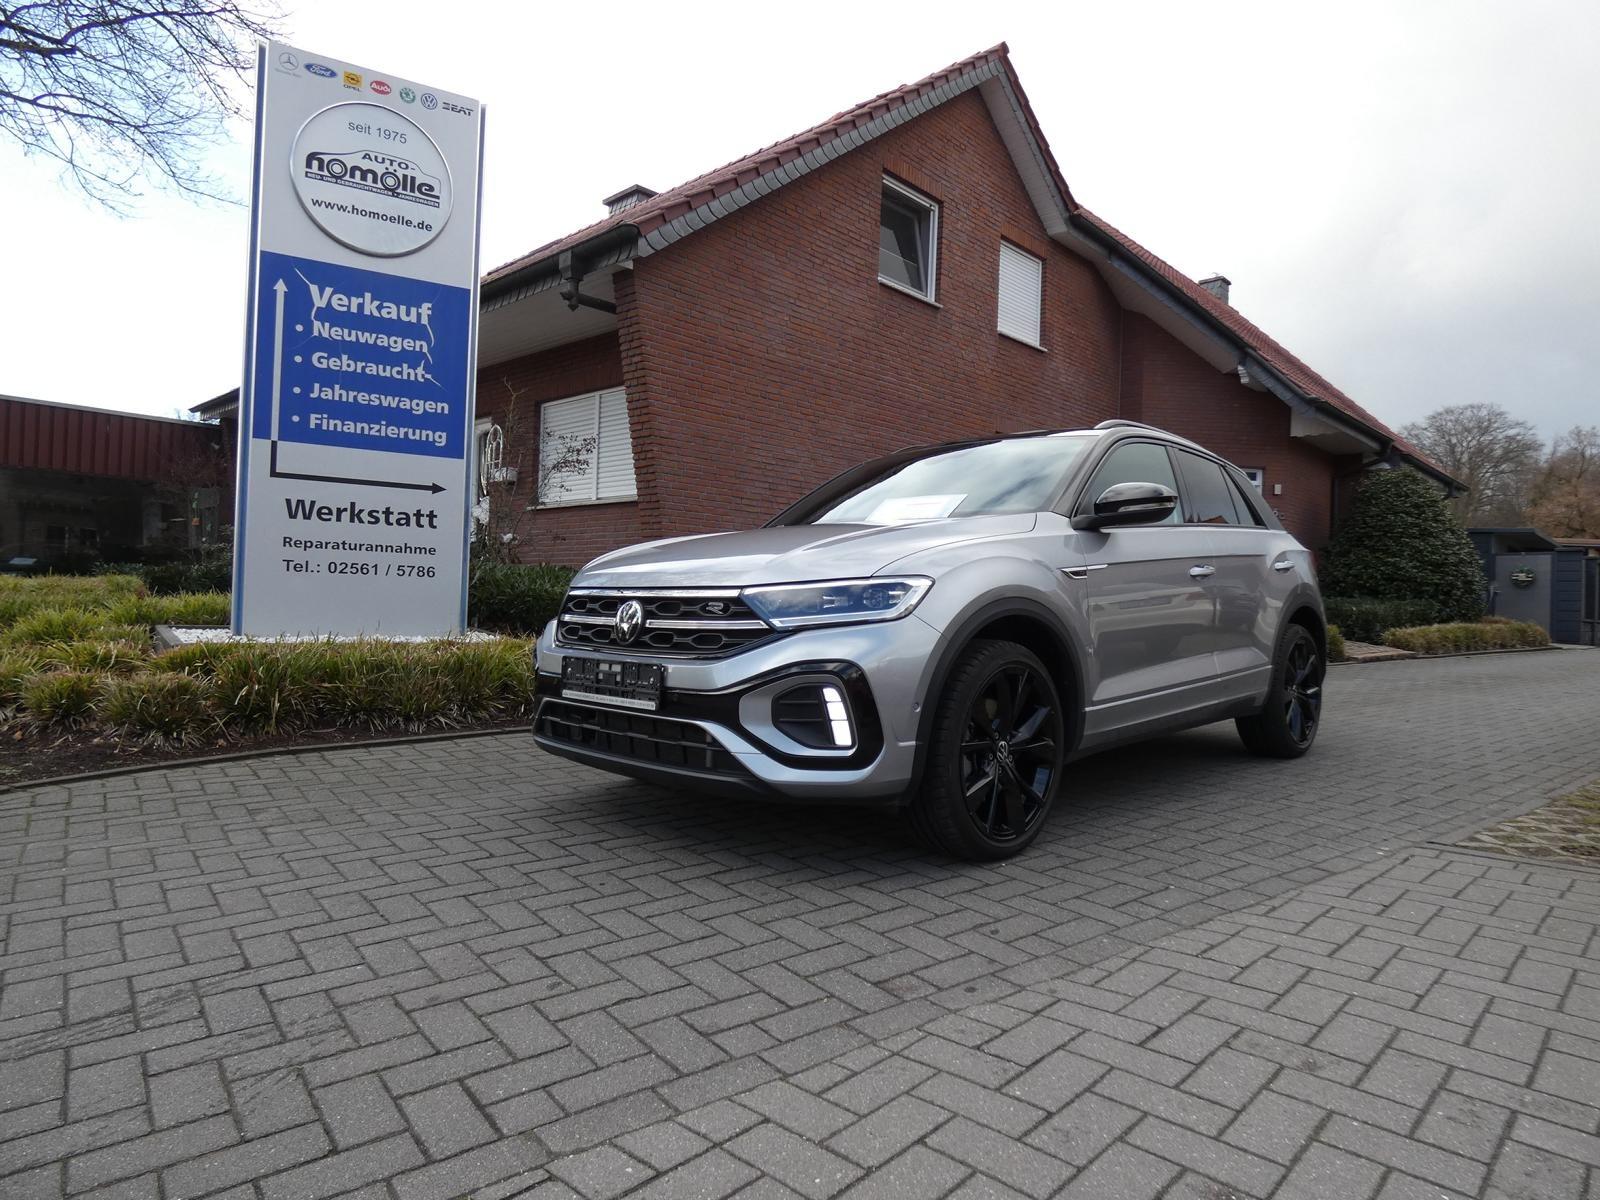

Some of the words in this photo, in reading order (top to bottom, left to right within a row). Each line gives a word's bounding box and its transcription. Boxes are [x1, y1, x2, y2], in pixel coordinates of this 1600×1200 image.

[310, 64, 332, 77] Ford
[371, 82, 391, 93] Audi
[442, 101, 474, 116] SEAT
[348, 120, 371, 136] seit
[376, 127, 407, 144] 1975
[361, 152, 416, 171] AUTO-
[311, 198, 433, 232] www.homoelle.de
[309, 284, 432, 325] Verkauf
[313, 321, 428, 352] Neuwagen
[309, 382, 449, 415] Jahreswagen
[309, 413, 447, 447] Finanzierung
[285, 498, 438, 529] Werkstatt
[282, 536, 437, 556] Reparaturannahme
[282, 559, 321, 574] Tel.:
[327, 561, 378, 576] 02561
[396, 565, 436, 578] 5786
